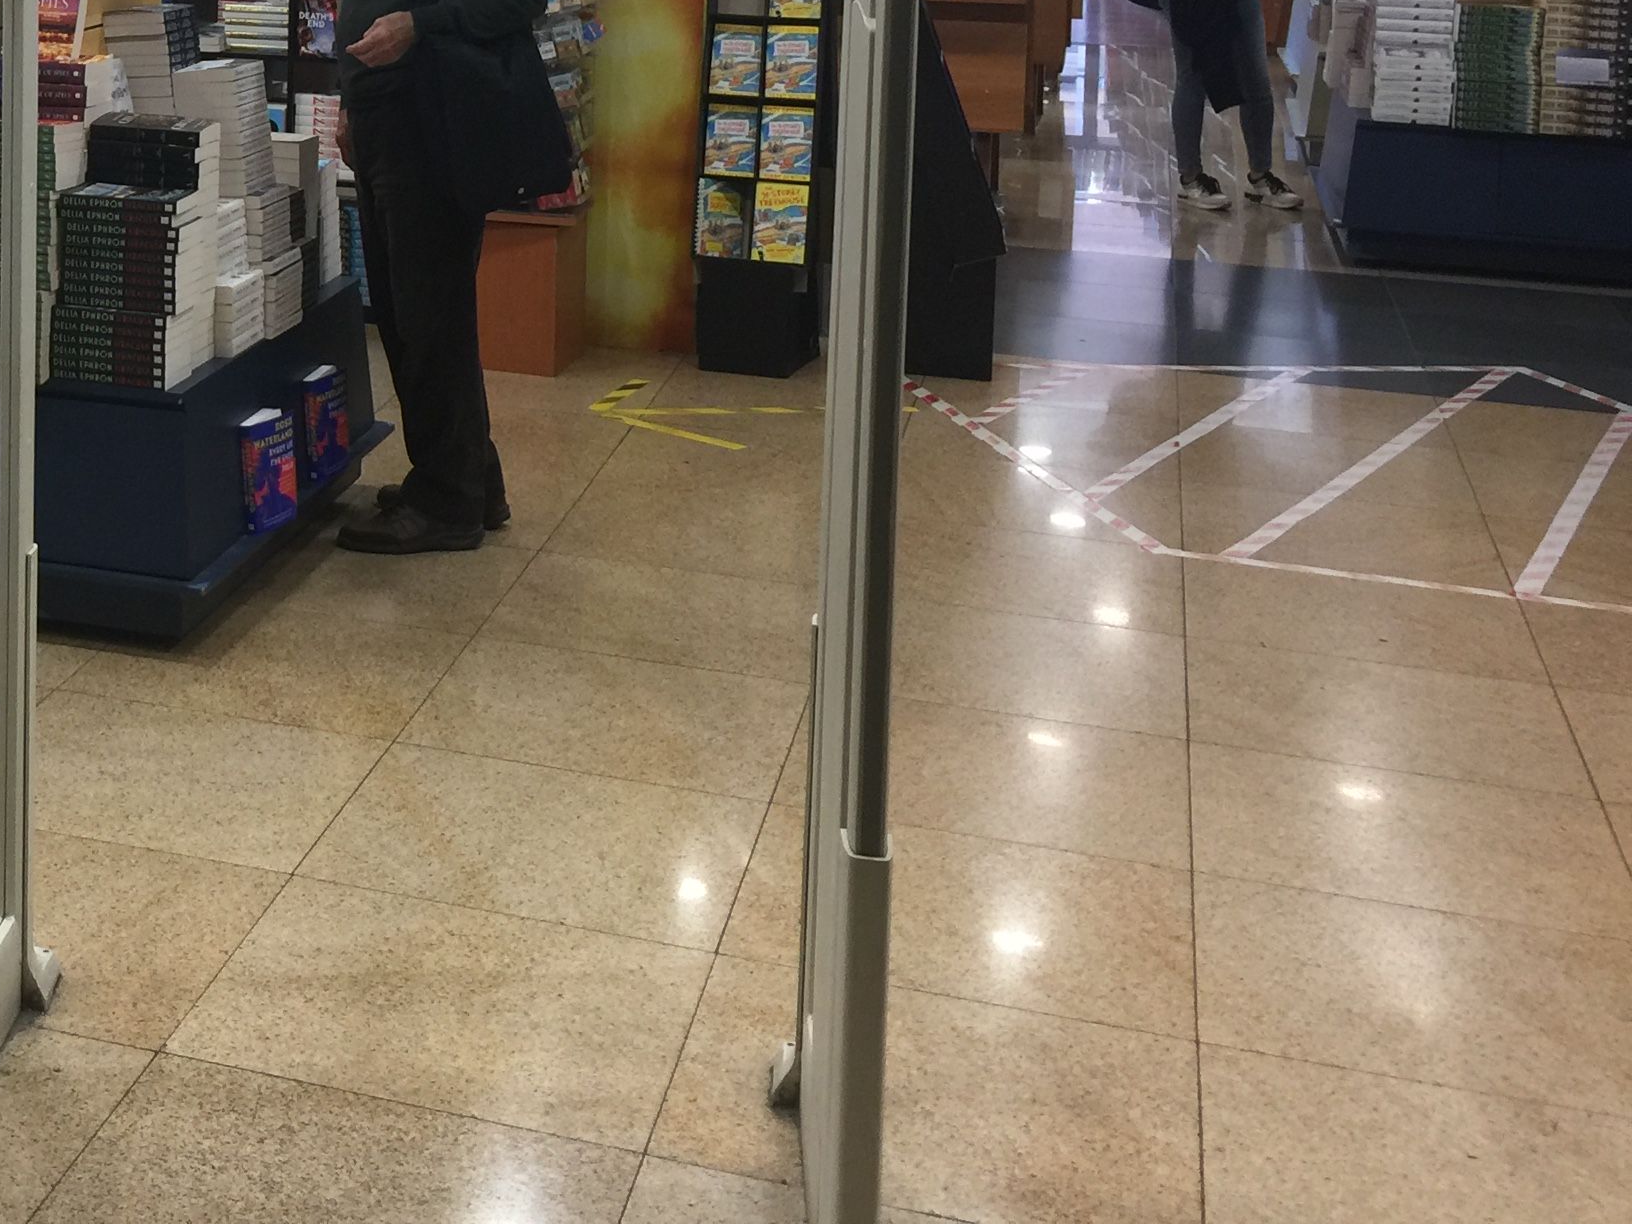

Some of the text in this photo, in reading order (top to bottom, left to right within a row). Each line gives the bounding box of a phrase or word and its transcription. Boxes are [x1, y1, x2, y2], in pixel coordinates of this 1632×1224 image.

[64, 197, 123, 208] DELIA EPHRON
[56, 307, 114, 320] DELIA EPHRON
